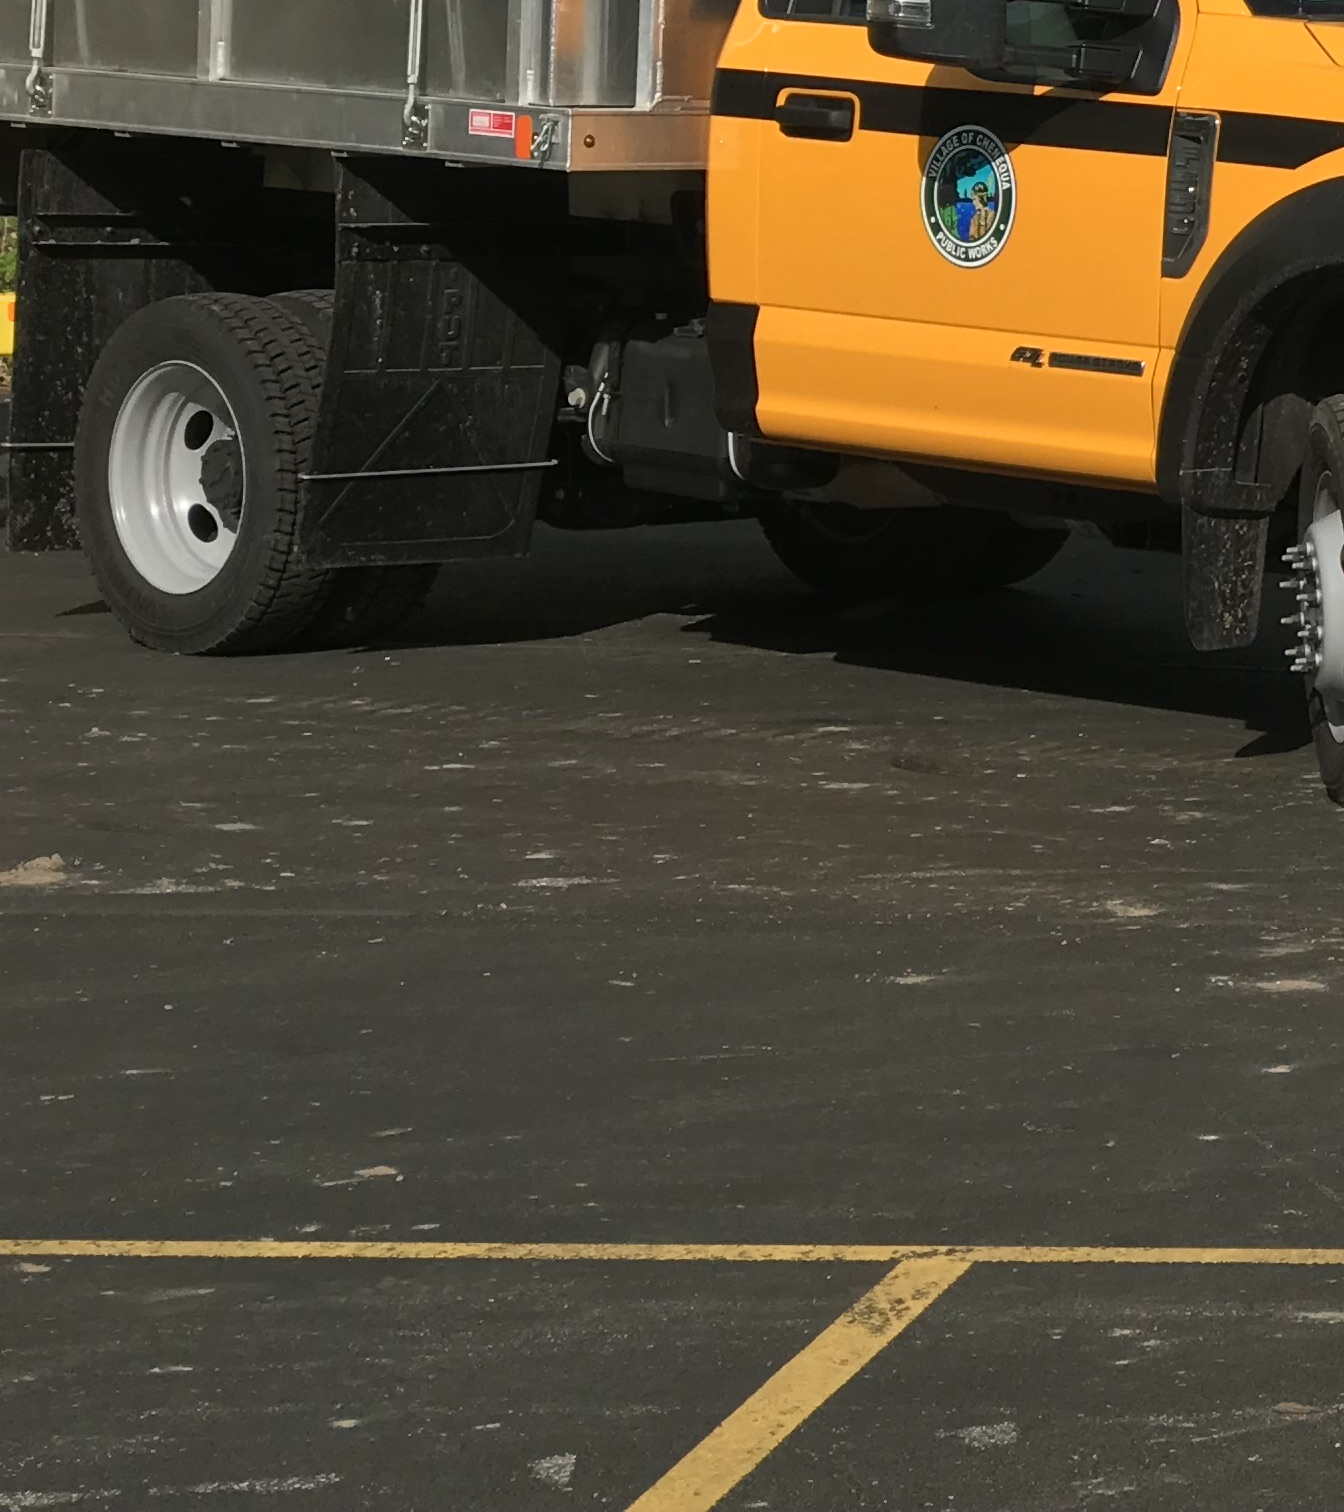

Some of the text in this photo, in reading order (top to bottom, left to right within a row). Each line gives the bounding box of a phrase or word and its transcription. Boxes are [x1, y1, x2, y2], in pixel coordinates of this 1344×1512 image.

[928, 132, 1012, 191] VILLAGE OF CHENEQUA
[936, 230, 999, 260] PUBLIC WORKS
